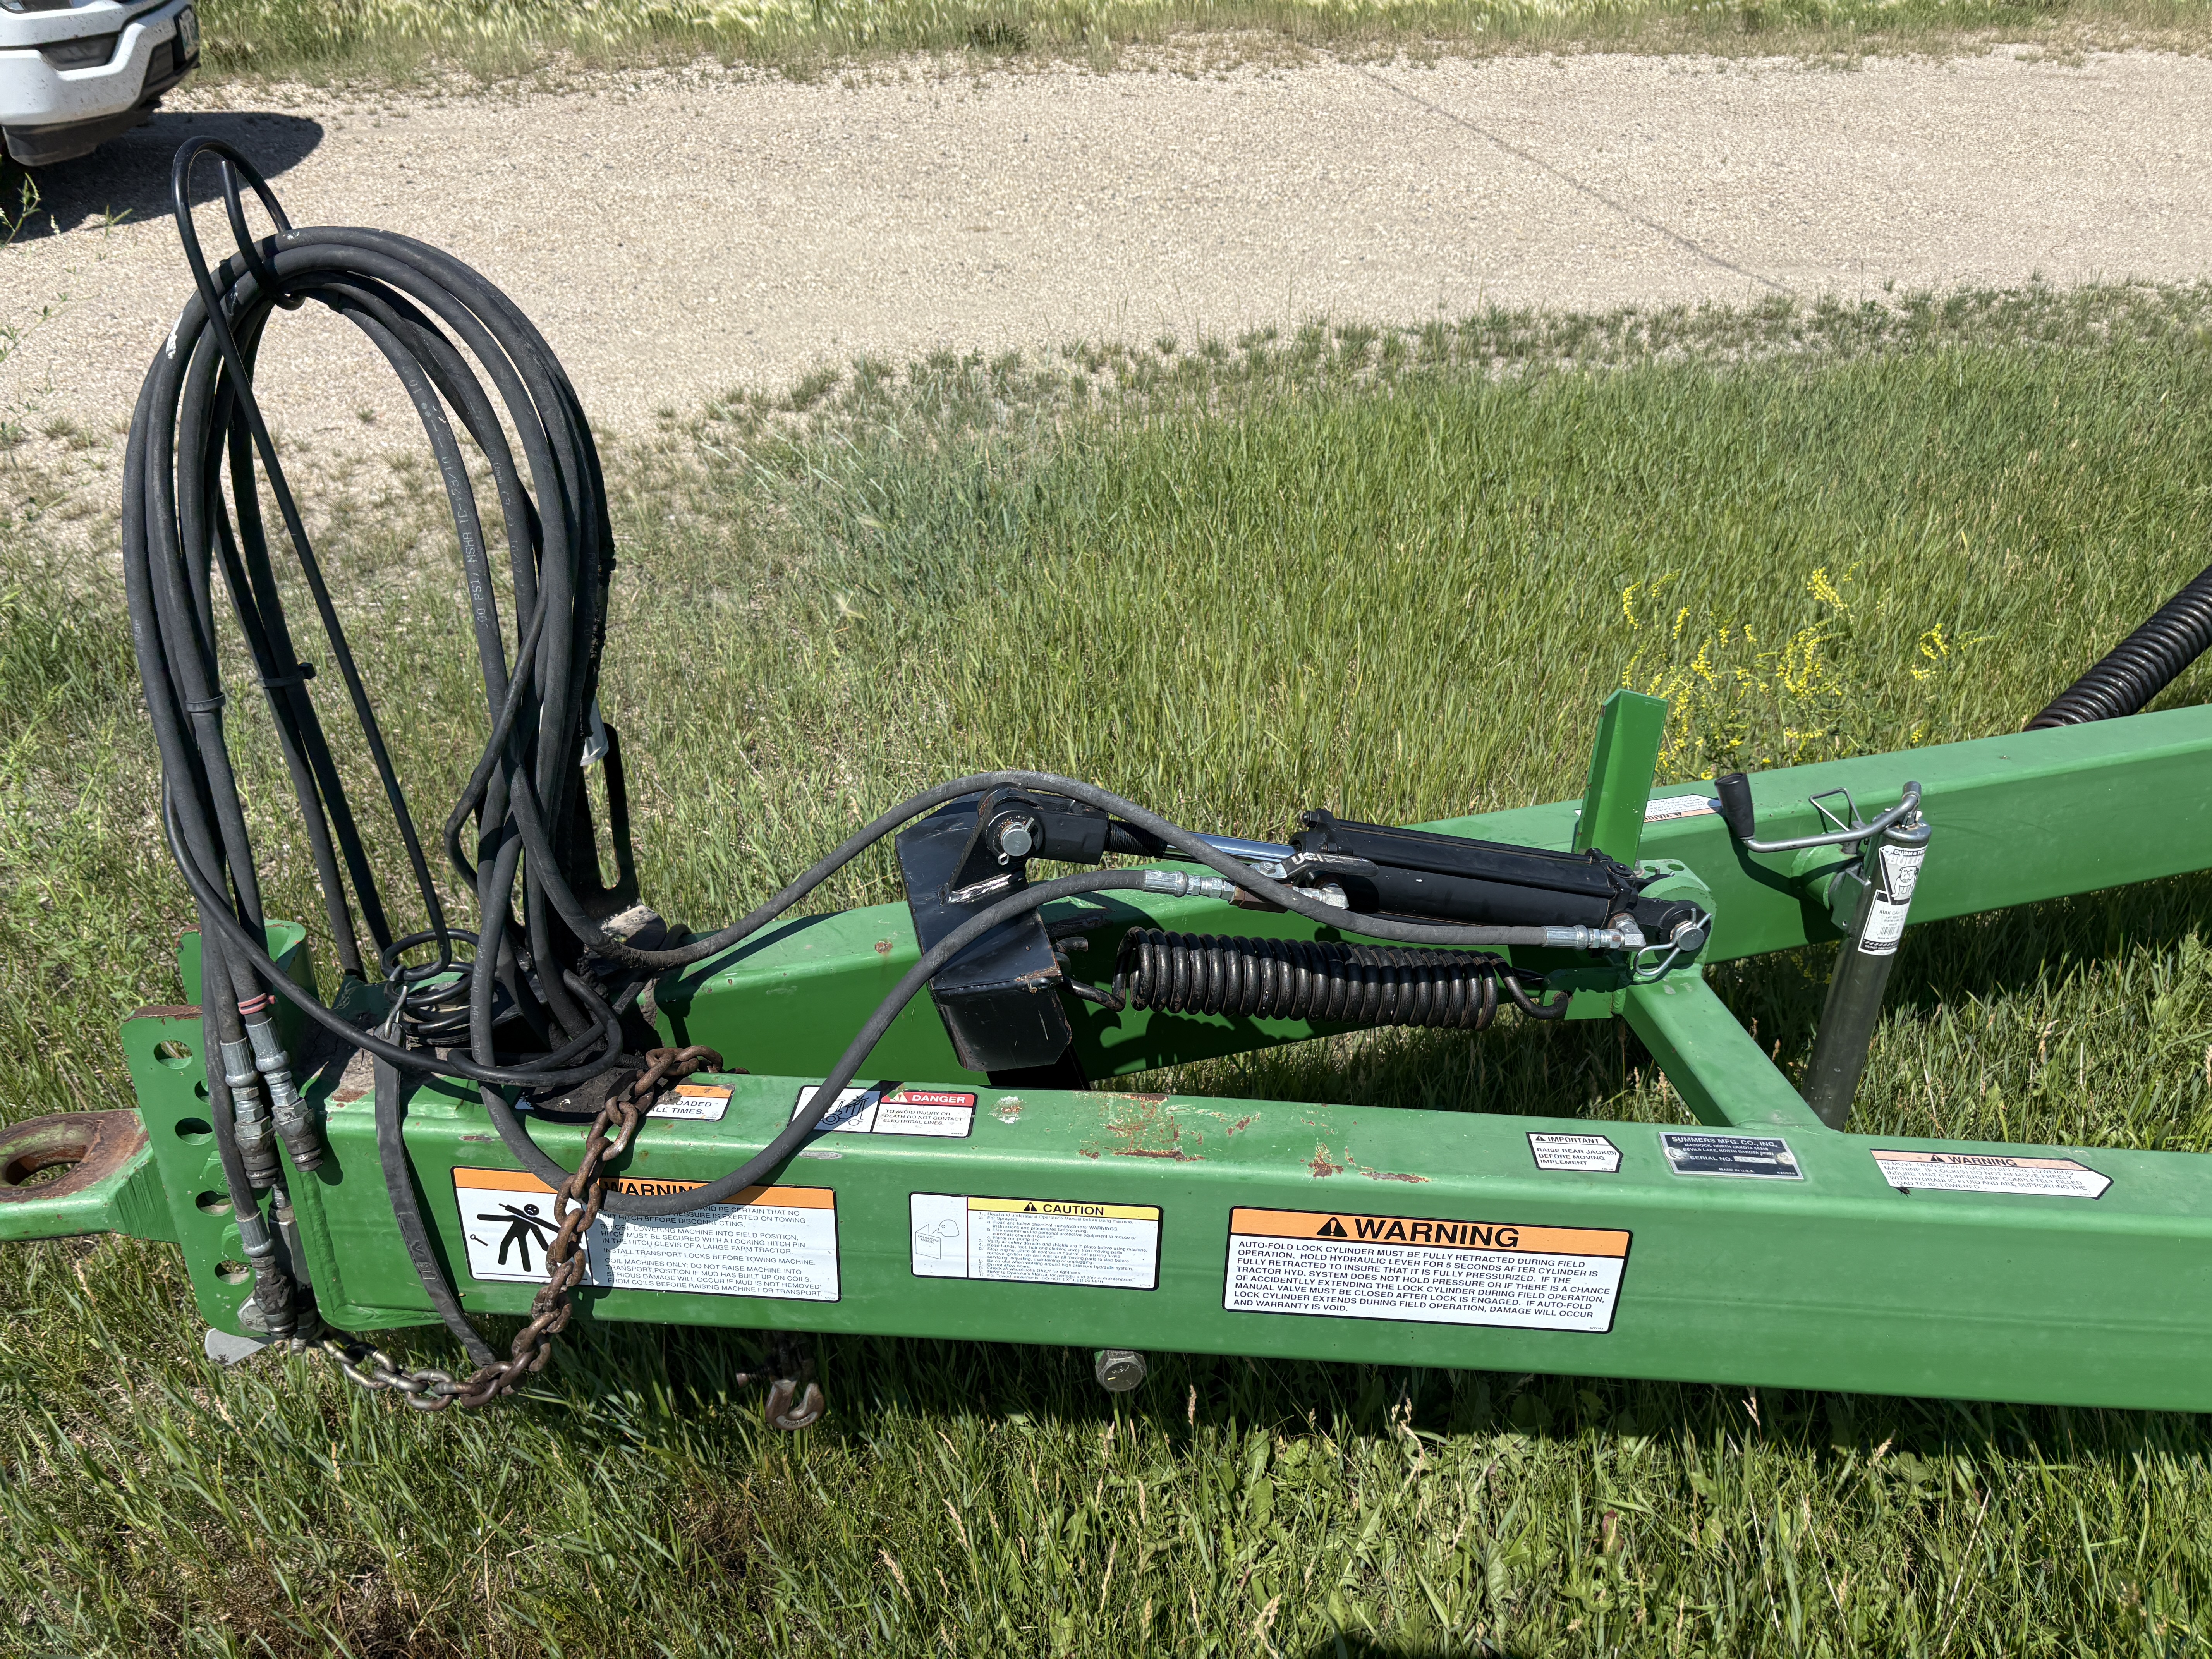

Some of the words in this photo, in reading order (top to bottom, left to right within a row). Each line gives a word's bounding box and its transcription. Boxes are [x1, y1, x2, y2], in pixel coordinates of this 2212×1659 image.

[912, 1094, 965, 1103] DANGER
[1948, 1156, 2017, 1166] WARNING
[604, 1181, 692, 1196] WARNI
[1043, 1204, 1104, 1215] CAUTION
[598, 1212, 617, 1221] UNIT
[678, 1218, 745, 1227] DISCONNECTING.
[600, 1223, 632, 1231] BEFORE
[760, 1233, 798, 1241] POSITION,
[1354, 1218, 1518, 1247] WARNING
[1238, 1241, 1293, 1250] AUTO-FOLD
[1325, 1246, 1374, 1255] CYLINDER
[1455, 1254, 1515, 1263] RETRACTED
[1517, 1258, 1555, 1266] DURING
[1238, 1249, 1295, 1259] OPERATION.
[1329, 1255, 1386, 1264] HYDRAULIC
[1388, 1258, 1420, 1266] LEVER
[1454, 1262, 1501, 1271] SECONDS
[1538, 1267, 1587, 1276] CYLINDER
[1238, 1266, 1281, 1274] TRACTOR
[1309, 1271, 1348, 1279] SYSTEM
[1432, 1278, 1485, 1287] PRESSURE
[1268, 1259, 1326, 1269] RETRACTED
[1344, 1264, 1380, 1272] INSURE
[1465, 1271, 1535, 1282] PRESSURIZED.
